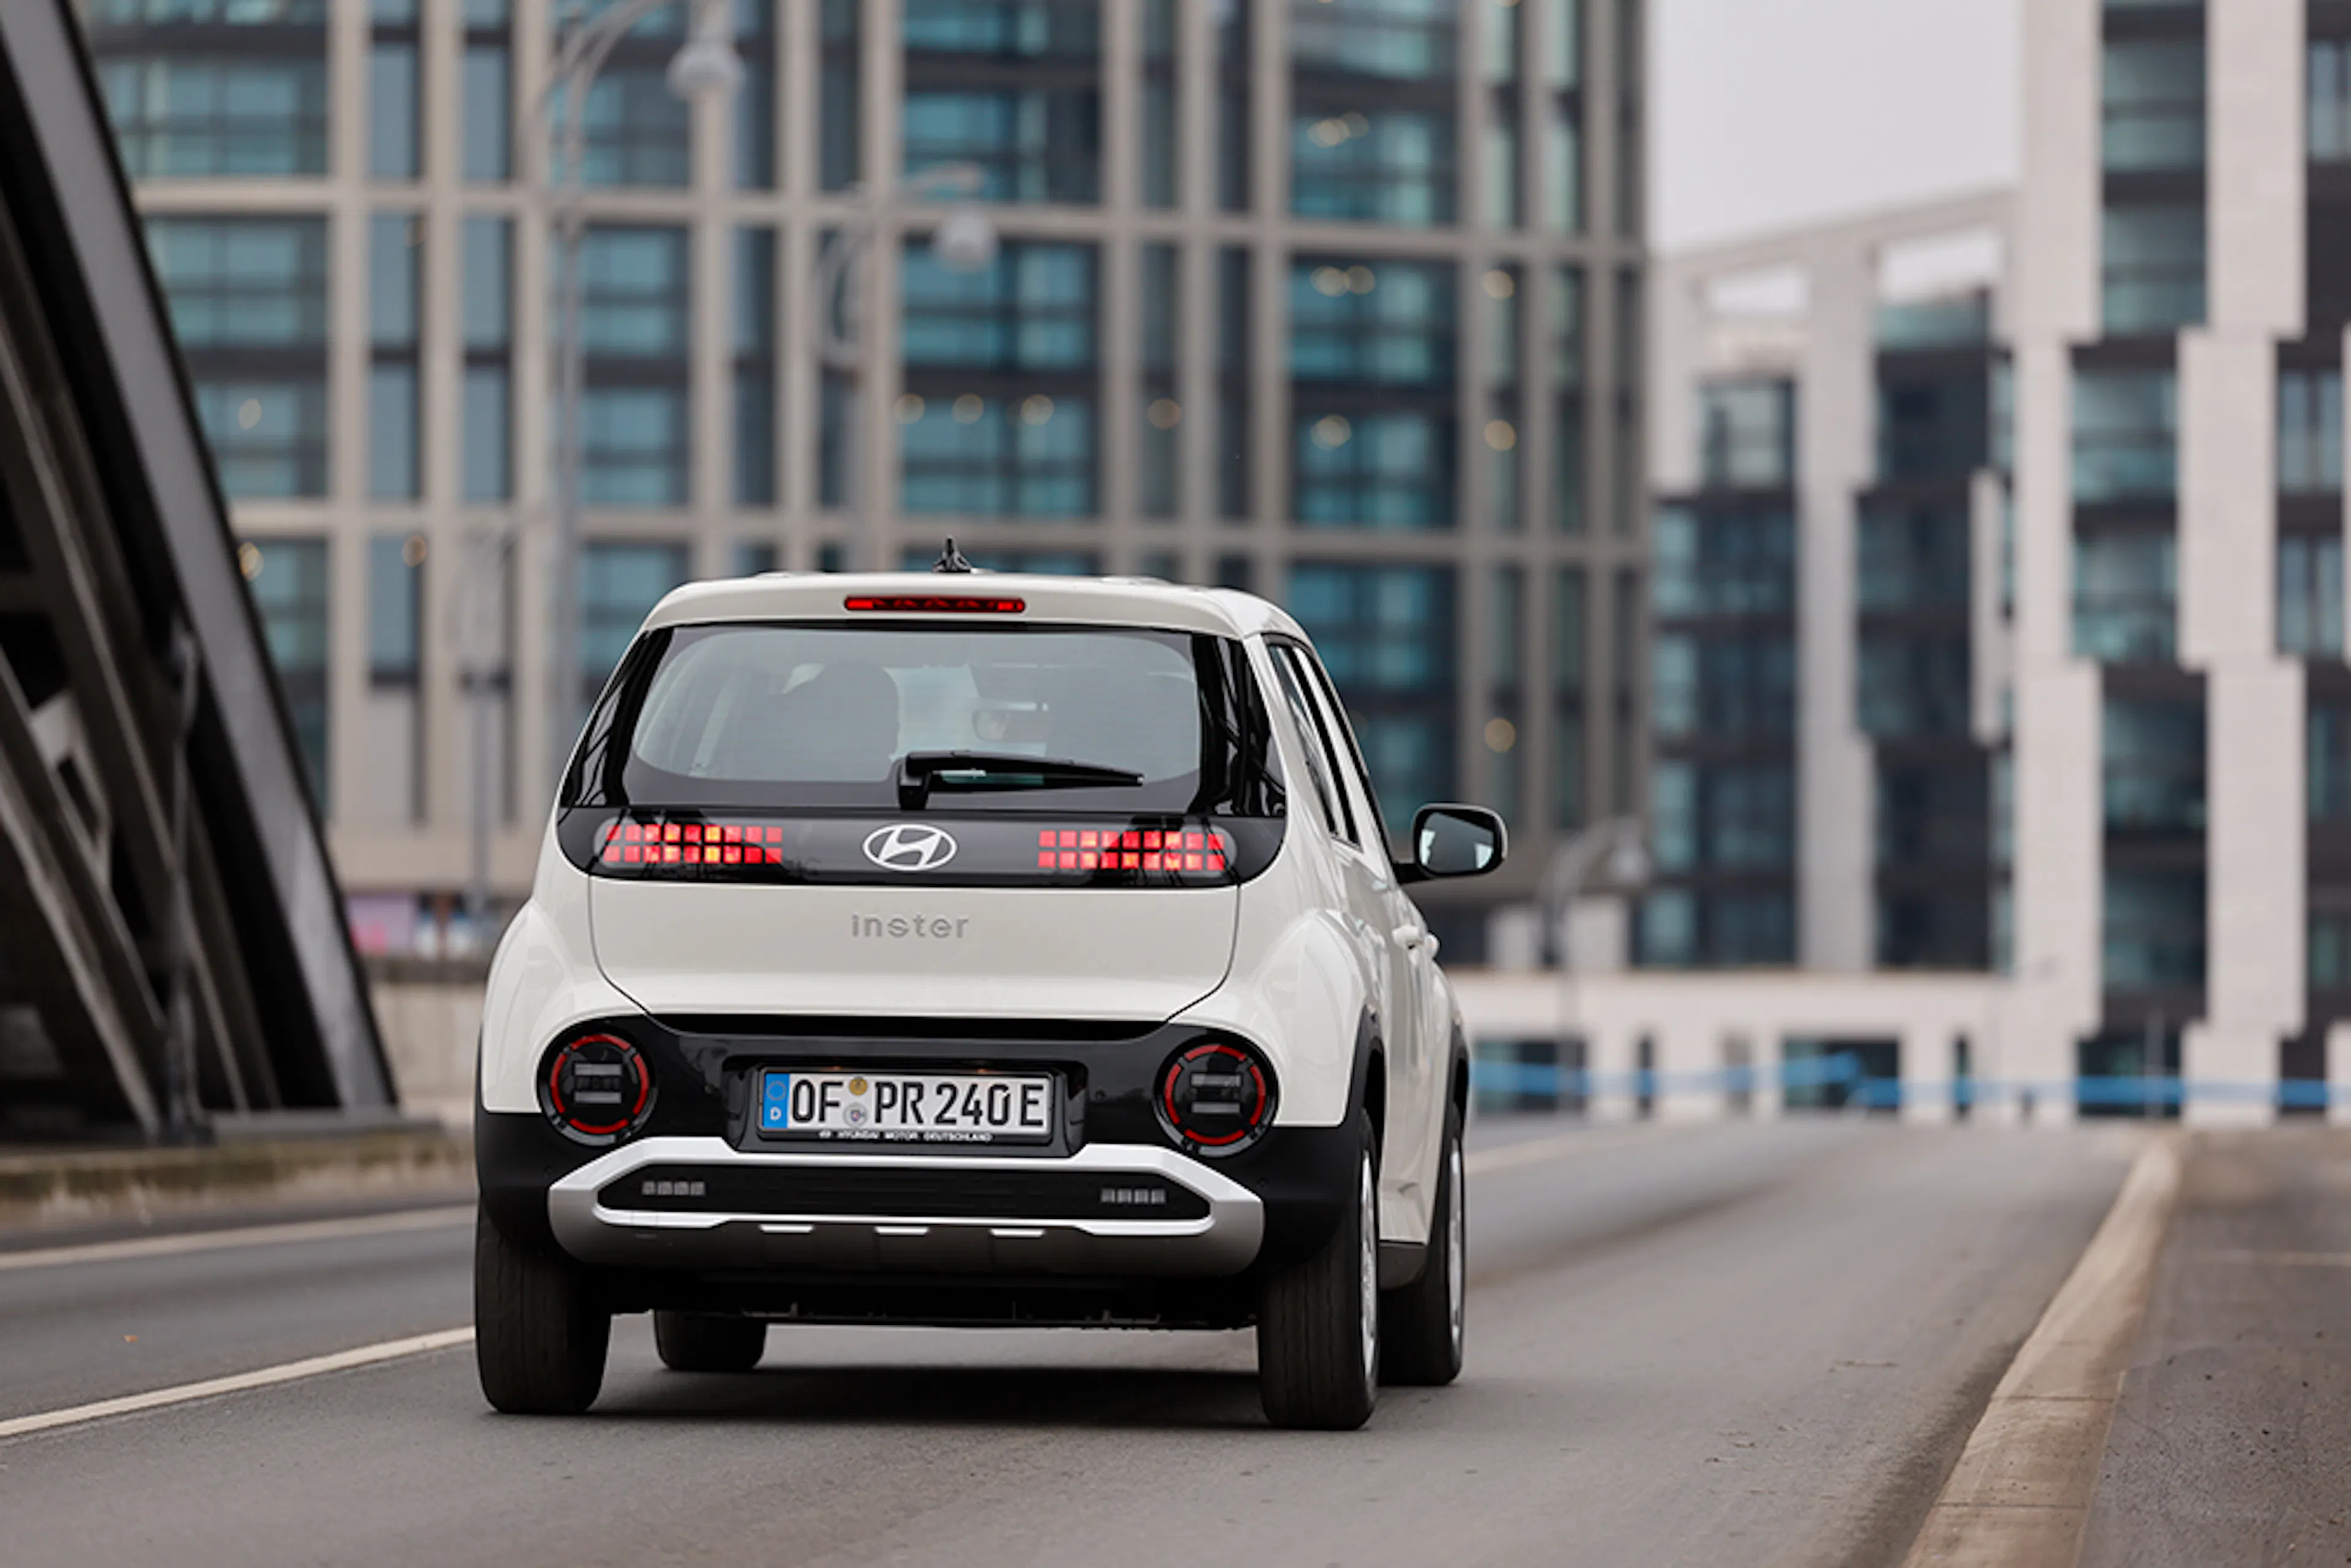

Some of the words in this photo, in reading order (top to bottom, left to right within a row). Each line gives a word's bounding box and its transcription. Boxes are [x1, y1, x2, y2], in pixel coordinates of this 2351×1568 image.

[852, 914, 969, 938] inster
[770, 1106, 782, 1120] D
[793, 1079, 843, 1123] OF
[875, 1081, 923, 1123] PR
